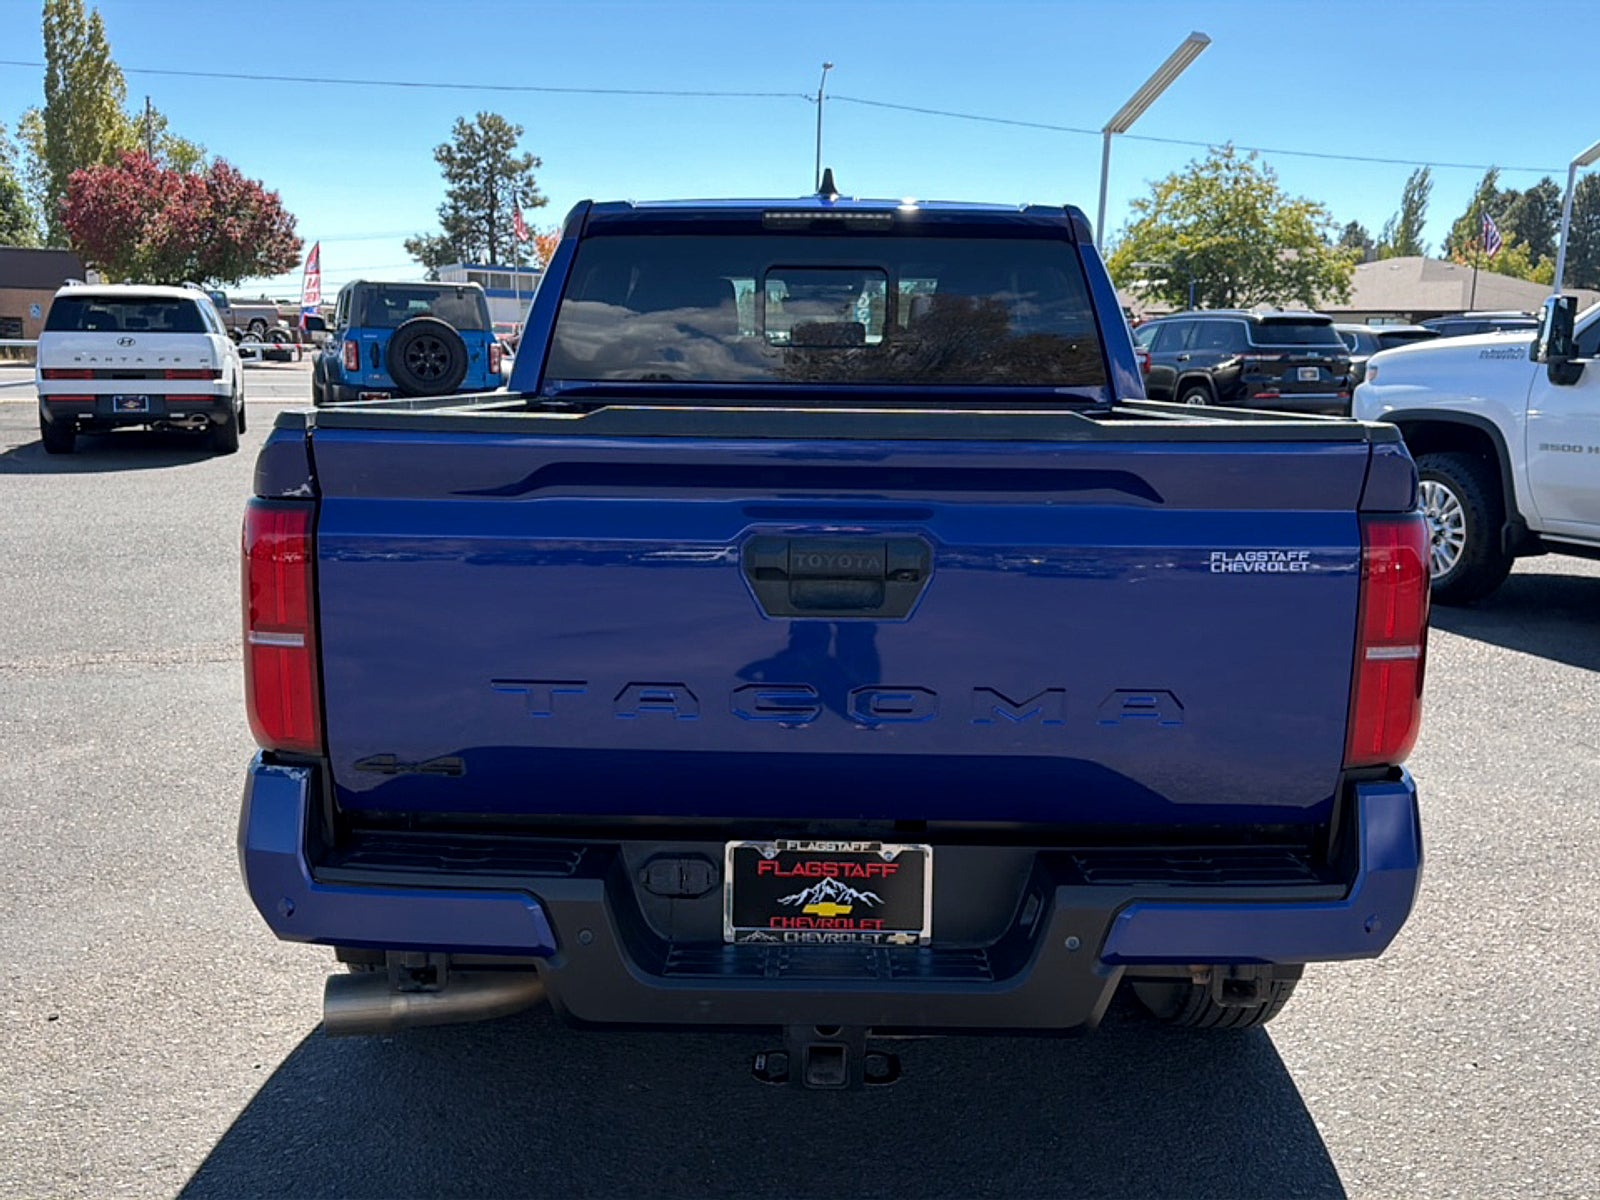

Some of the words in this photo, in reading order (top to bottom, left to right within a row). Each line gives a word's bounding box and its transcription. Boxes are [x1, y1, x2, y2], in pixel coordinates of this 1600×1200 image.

[795, 553, 881, 570] TOYOTA
[1210, 551, 1310, 561] FLAGSTAFF
[1210, 561, 1310, 573] CHEVROLET
[490, 678, 1186, 728] TACOMA
[786, 840, 872, 851] FLAGSTAFF
[757, 860, 900, 878] FLAGSTAFF
[770, 916, 885, 930] CHEVROLET
[783, 931, 882, 944] CHEVROLET
